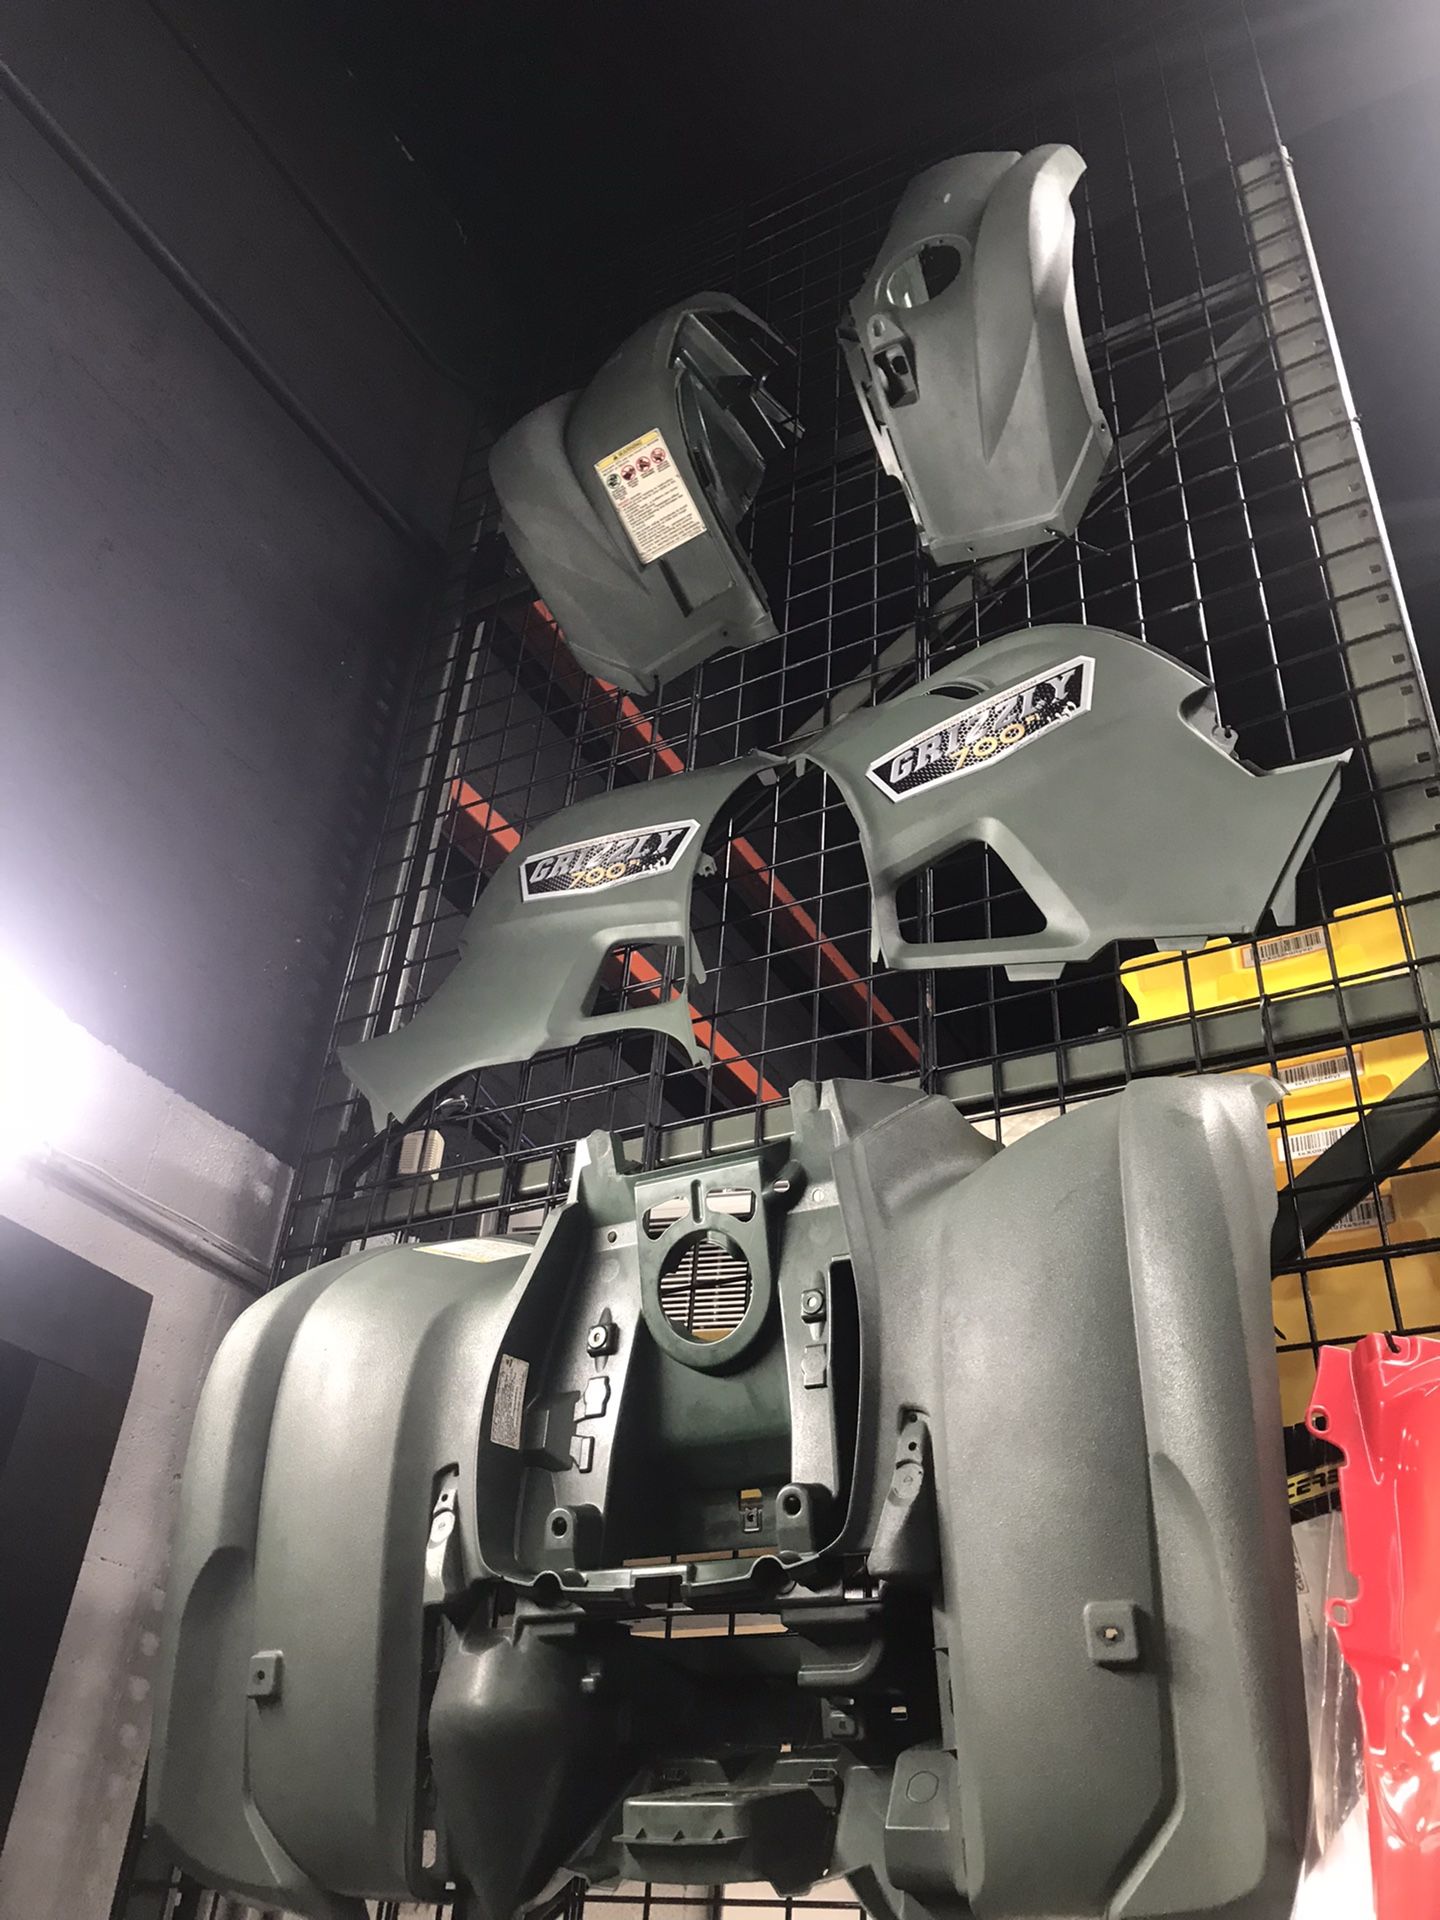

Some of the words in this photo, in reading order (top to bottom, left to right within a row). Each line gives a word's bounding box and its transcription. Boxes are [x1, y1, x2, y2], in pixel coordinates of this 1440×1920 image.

[889, 669, 1076, 783] GRIZZLY
[950, 723, 1025, 770] 700
[529, 829, 683, 883] GRIZZLY
[570, 862, 626, 889] 700
